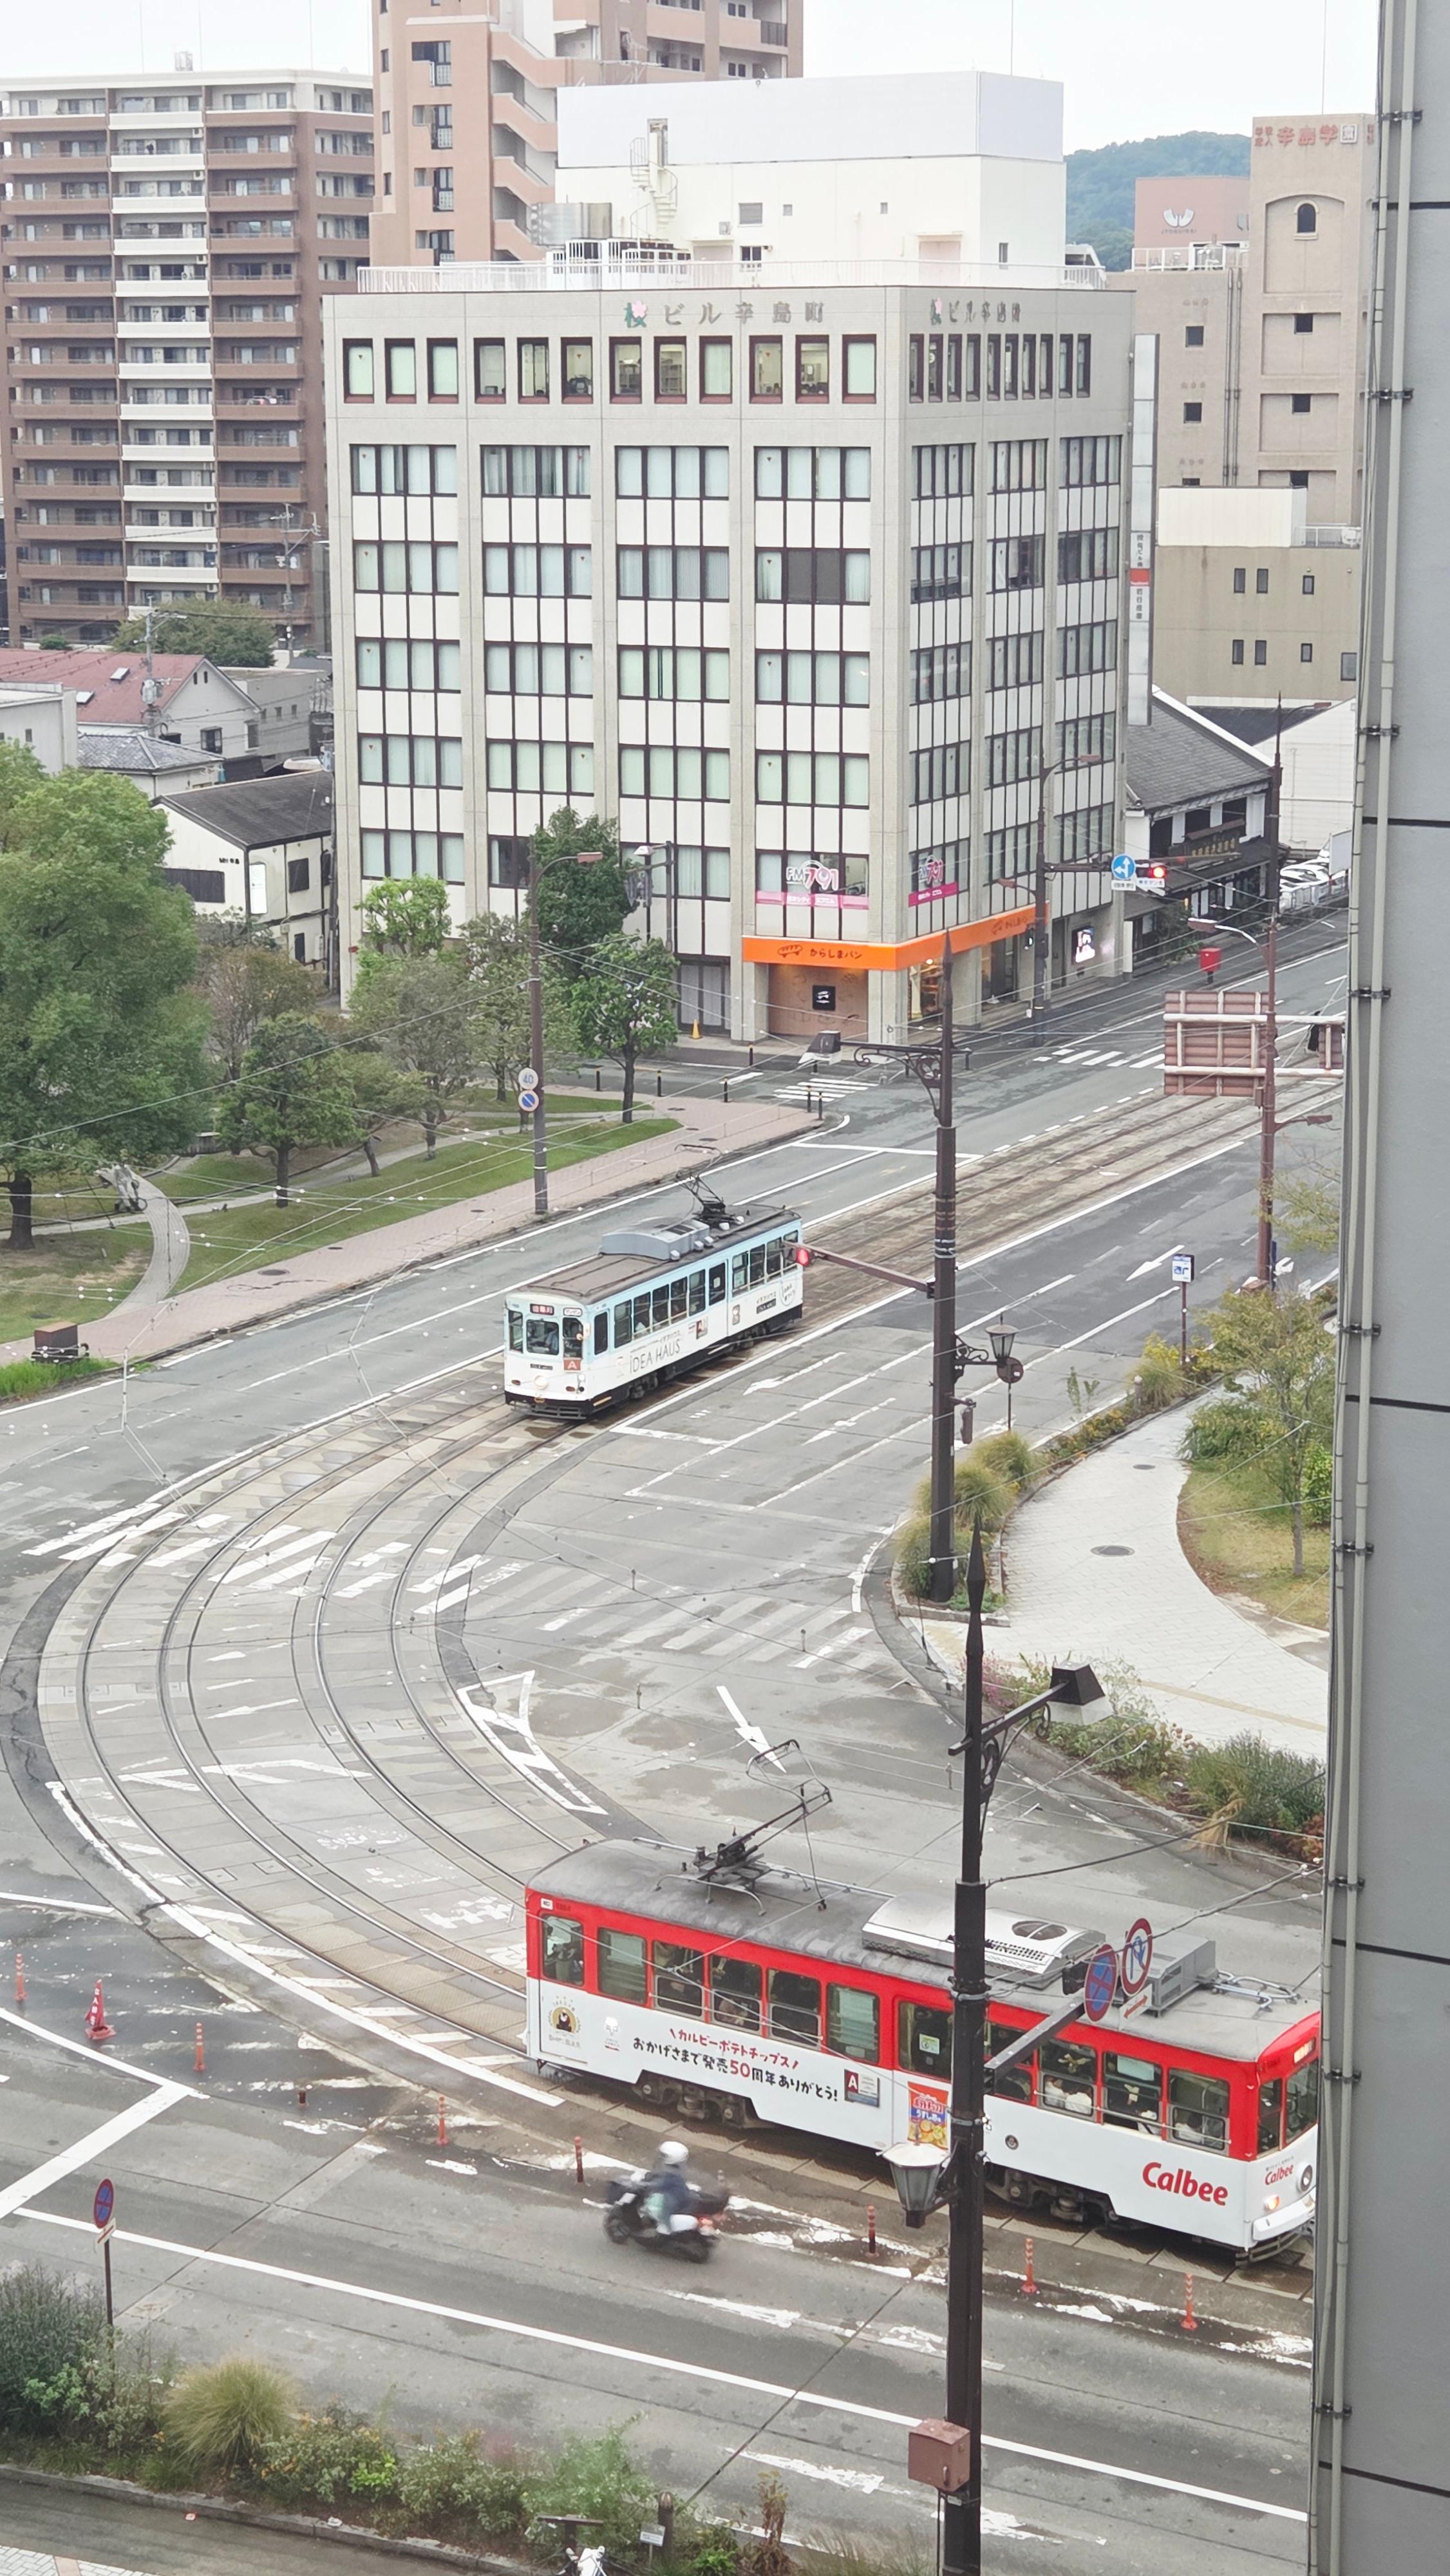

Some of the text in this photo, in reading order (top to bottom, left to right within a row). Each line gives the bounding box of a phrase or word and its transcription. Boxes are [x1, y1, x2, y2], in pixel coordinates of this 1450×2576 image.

[810, 948, 862, 960] からしまパン
[523, 1074, 534, 1084] 40
[630, 1339, 681, 1374] IDEA HAUS
[567, 1360, 578, 1370] A
[848, 2074, 858, 2090] A
[1265, 2164, 1294, 2185] Calbee
[1142, 2162, 1229, 2206] Calbee
